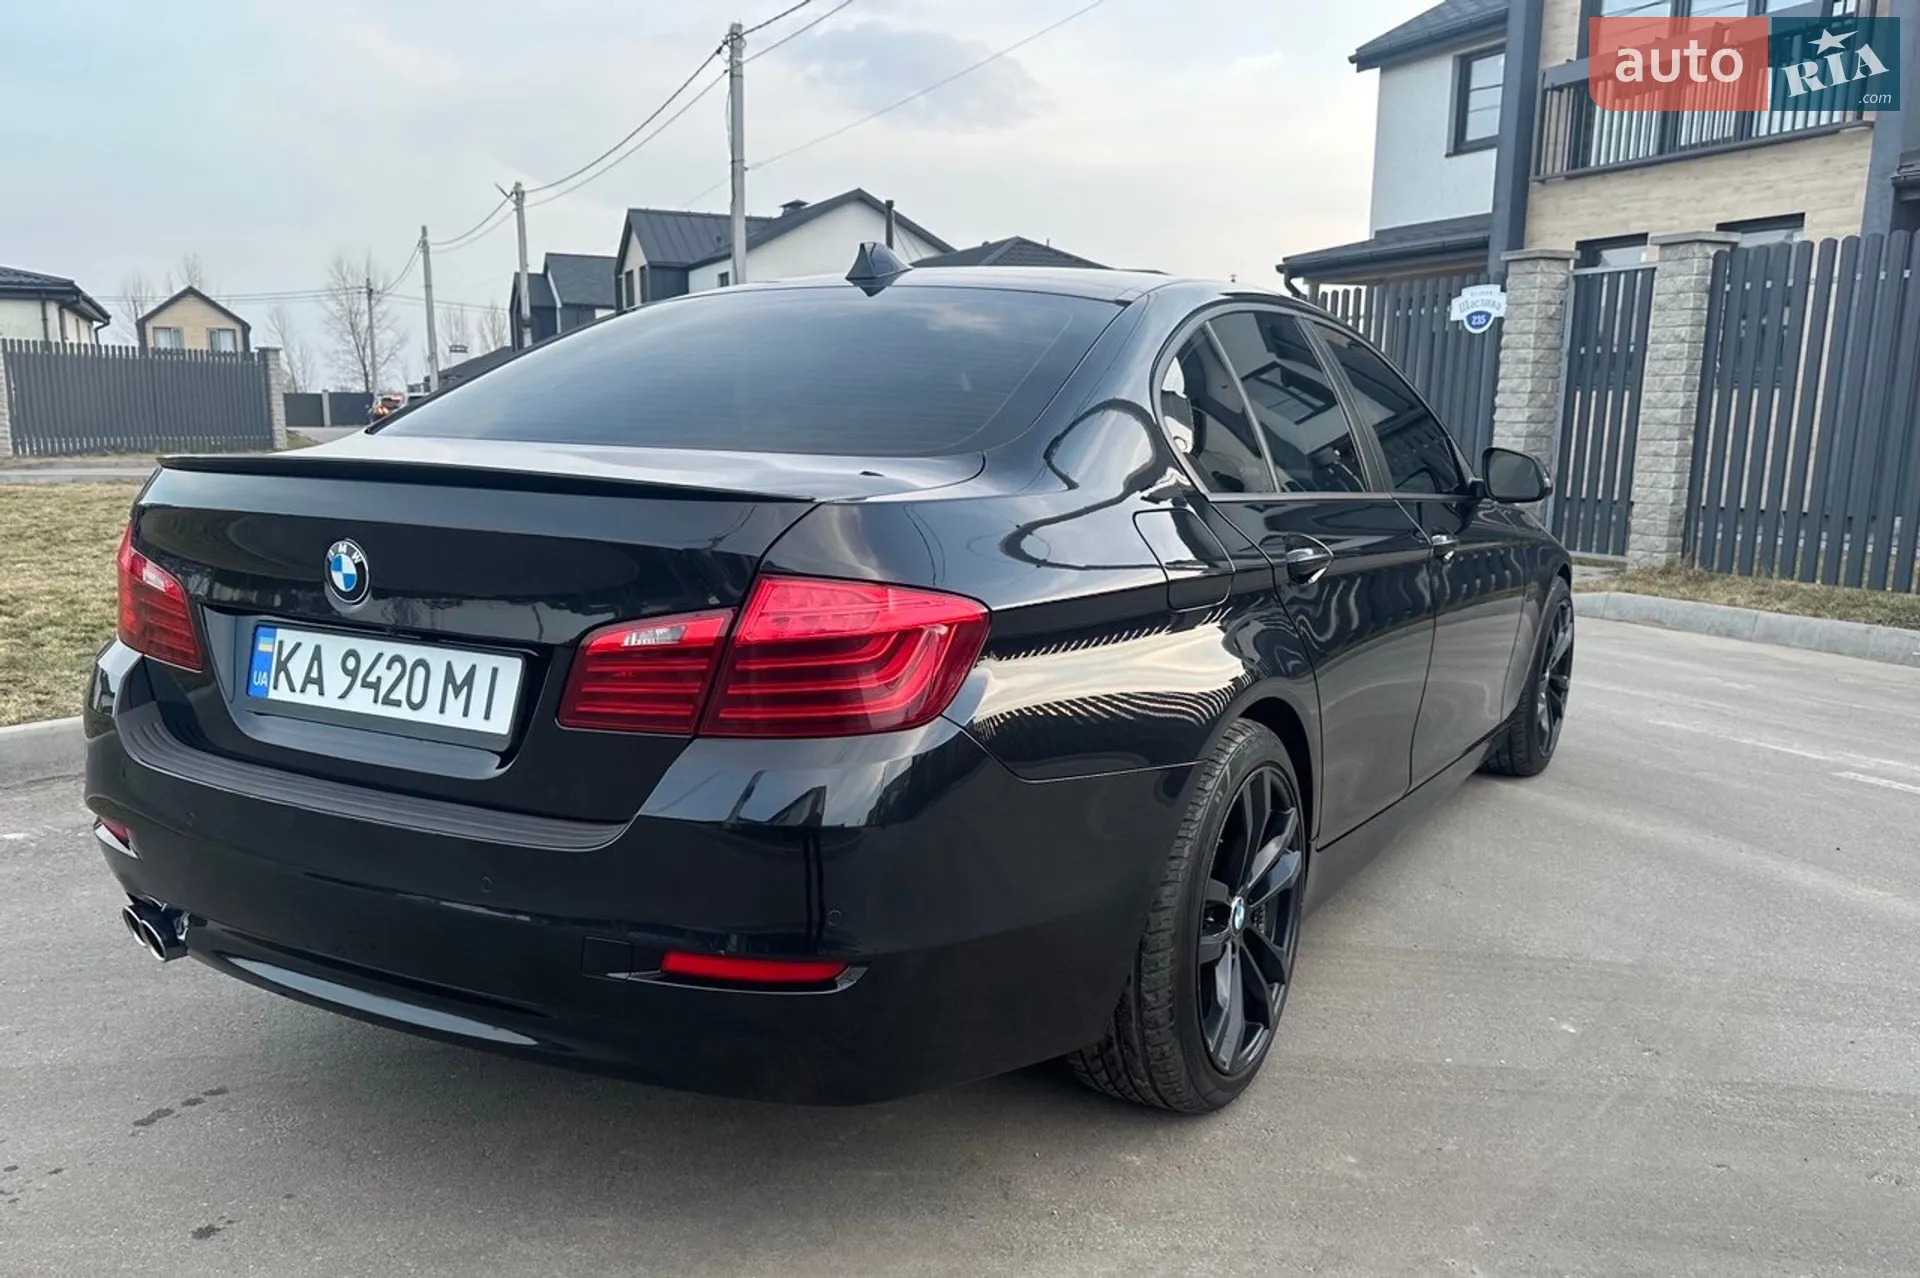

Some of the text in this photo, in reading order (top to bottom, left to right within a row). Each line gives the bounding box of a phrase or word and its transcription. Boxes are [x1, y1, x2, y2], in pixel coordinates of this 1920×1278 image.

[328, 542, 364, 564] BMW
[253, 670, 269, 688] UA
[273, 640, 499, 721] KA 9420 MI
